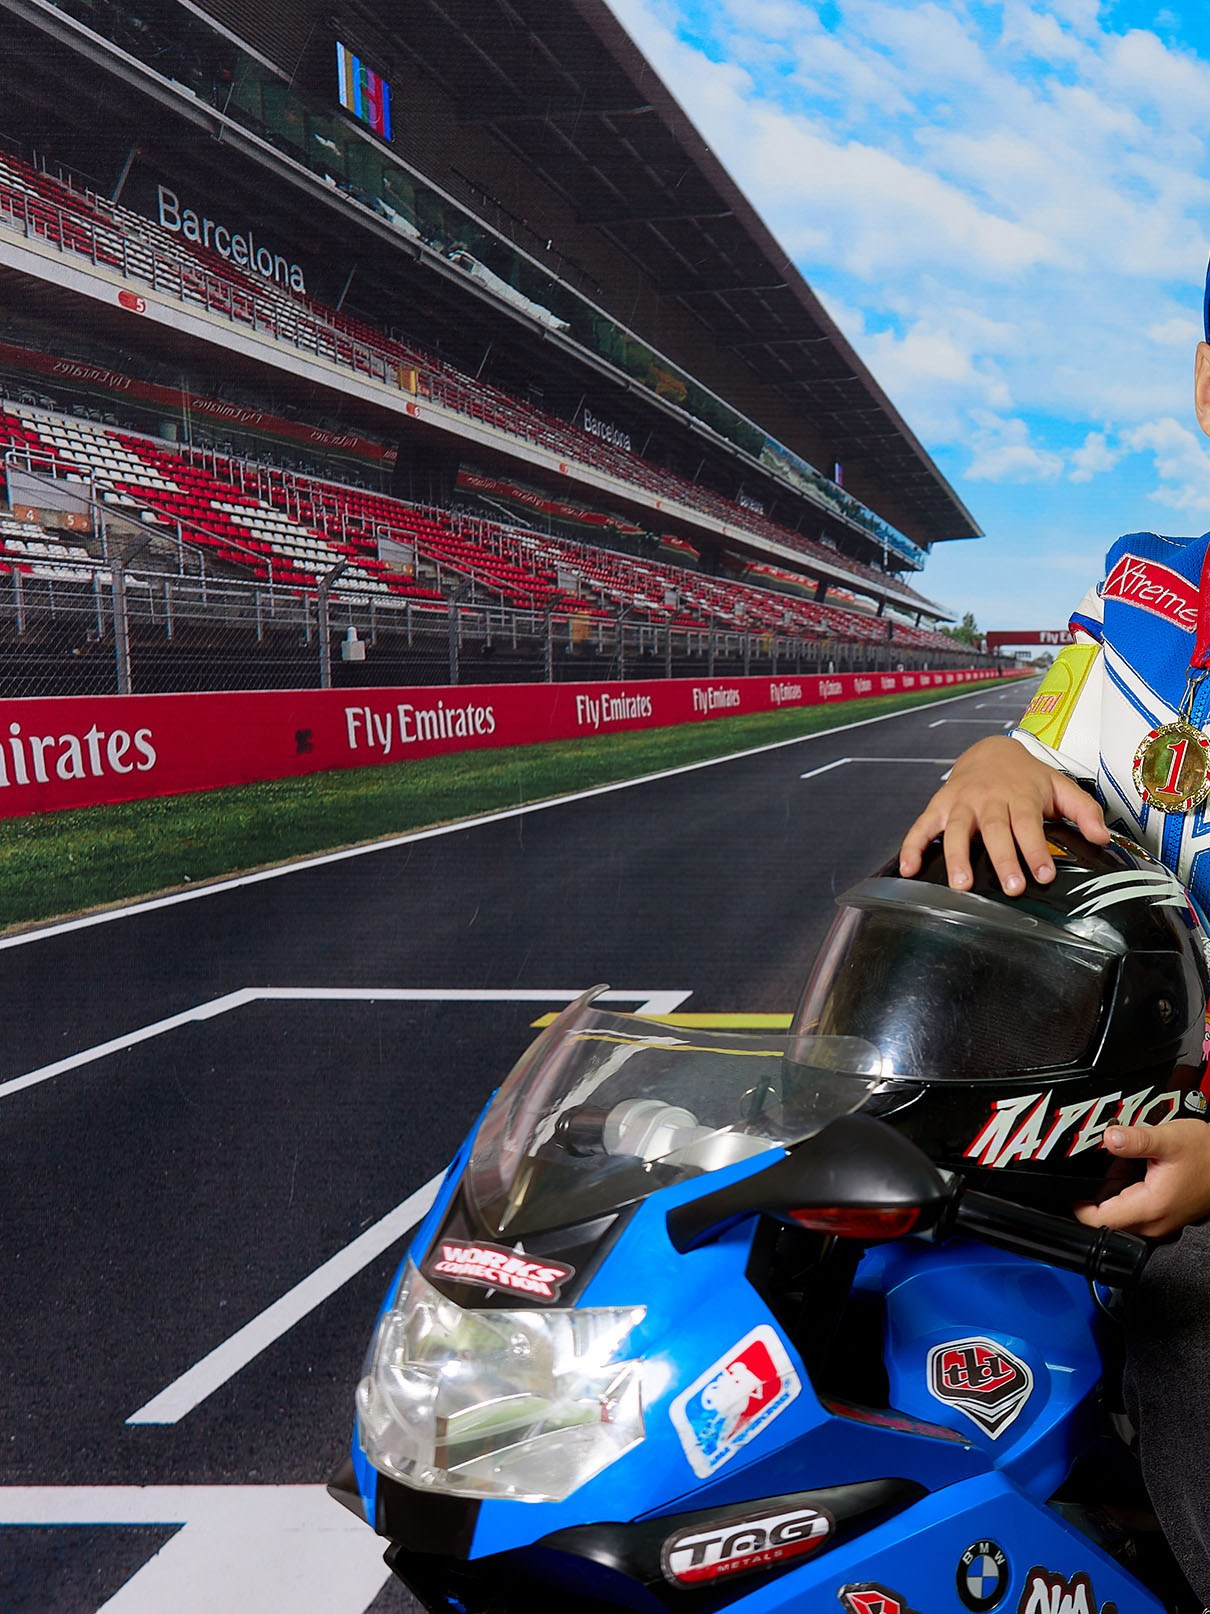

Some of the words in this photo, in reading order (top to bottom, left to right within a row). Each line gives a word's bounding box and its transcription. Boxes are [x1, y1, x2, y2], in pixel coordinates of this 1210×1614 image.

[158, 184, 306, 295] Barcelona
[136, 298, 146, 312] 5
[584, 408, 632, 451] Barcelona
[67, 514, 75, 526] 5
[1104, 558, 1199, 623] Xtreme
[576, 695, 600, 730] Fly
[601, 691, 653, 722] Emirates
[692, 688, 709, 714] Fly
[345, 706, 393, 754] Fly
[398, 700, 496, 744] Emirates
[1156, 739, 1189, 797] 1
[442, 1245, 567, 1283] WORKS
[670, 1513, 819, 1567] TAG
[962, 1542, 1006, 1566] BMW
[717, 1550, 784, 1573] METALS
